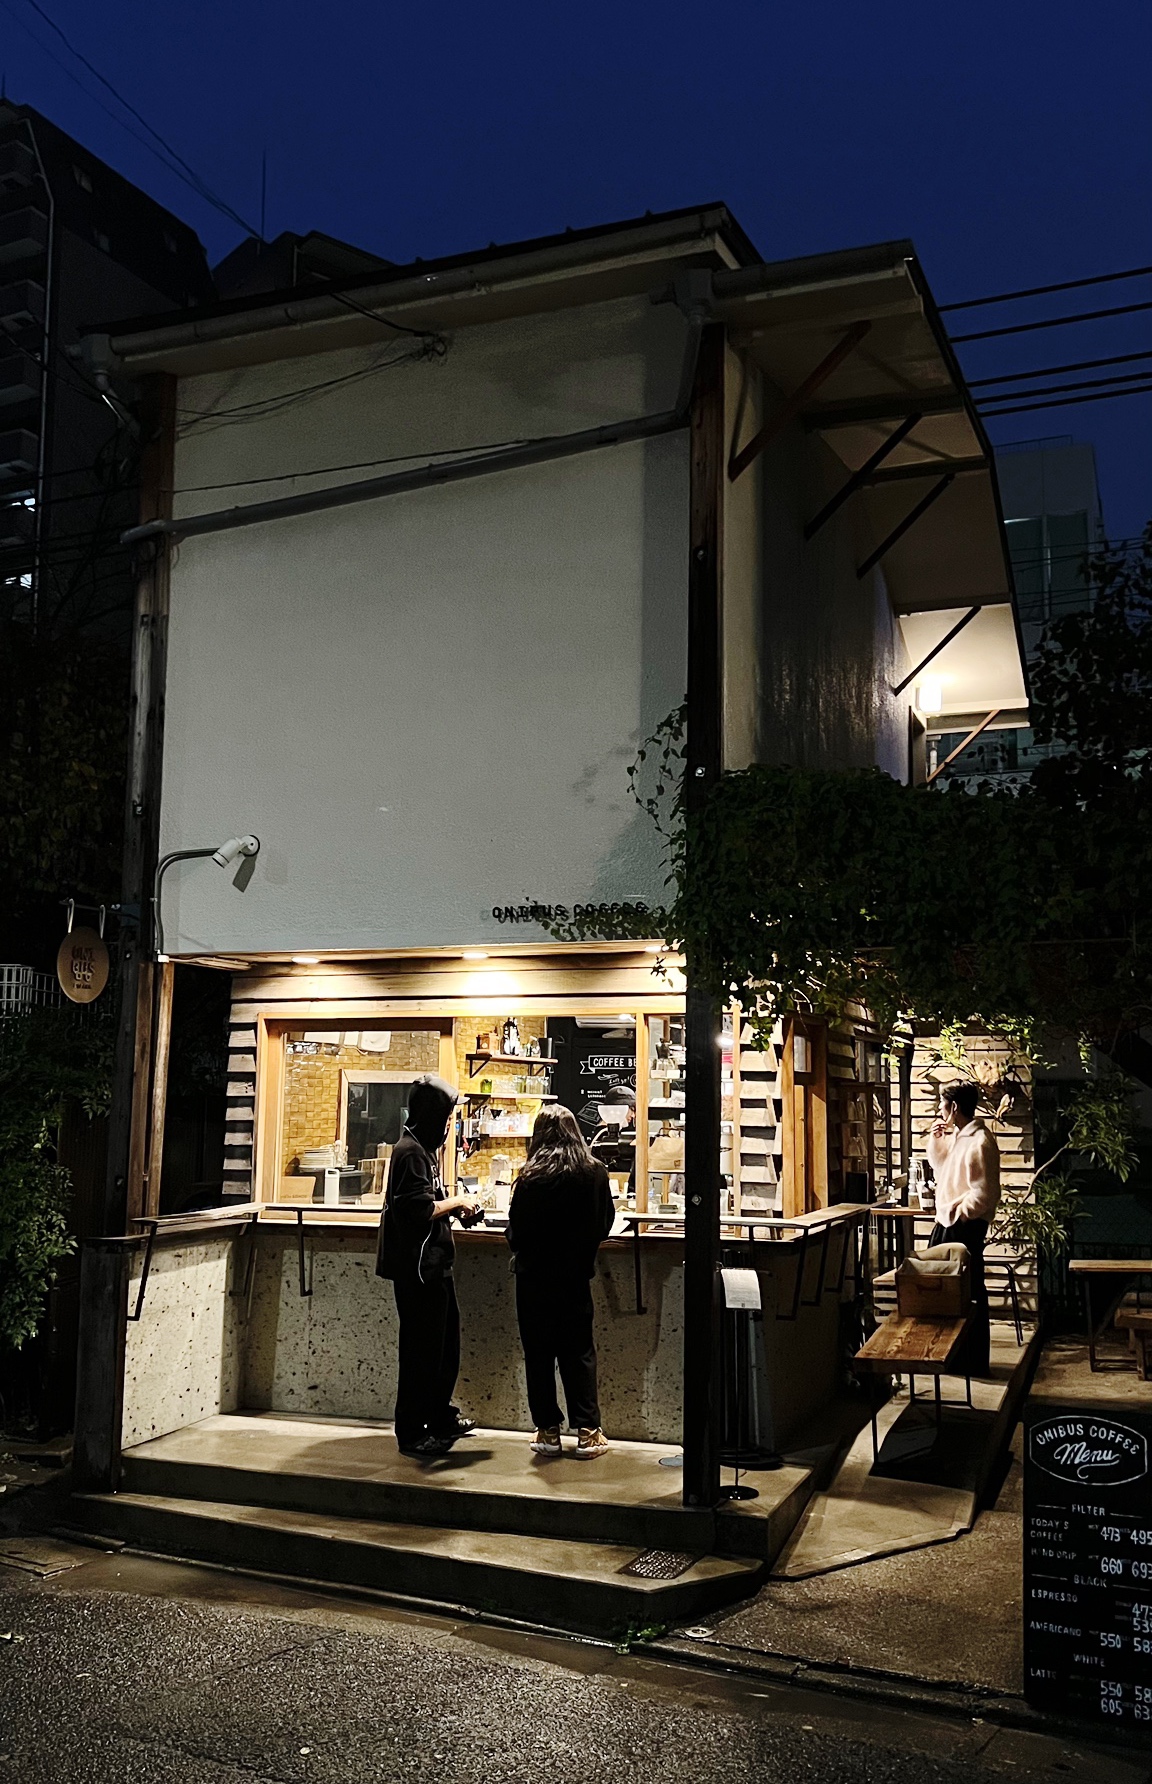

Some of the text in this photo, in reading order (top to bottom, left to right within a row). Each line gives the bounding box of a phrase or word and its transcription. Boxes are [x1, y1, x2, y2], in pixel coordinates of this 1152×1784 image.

[593, 1058, 625, 1067] COFFEE
[1090, 1425, 1140, 1454] COFFEE
[1053, 1442, 1121, 1479] Menu
[1071, 1504, 1106, 1516] FILTER
[1100, 1526, 1121, 1542] 473
[1130, 1529, 1152, 1546] 495
[1031, 1548, 1055, 1558] HND
[1101, 1557, 1123, 1574] 660
[1074, 1574, 1107, 1588] BLACK
[1031, 1589, 1079, 1603] ESPRESSO
[1029, 1620, 1152, 1655] AMERICANO 550 58
[1073, 1653, 1106, 1668] WHITE
[1030, 1668, 1057, 1680] LATTE
[1100, 1680, 1122, 1697] 550
[1101, 1697, 1123, 1716] 605
